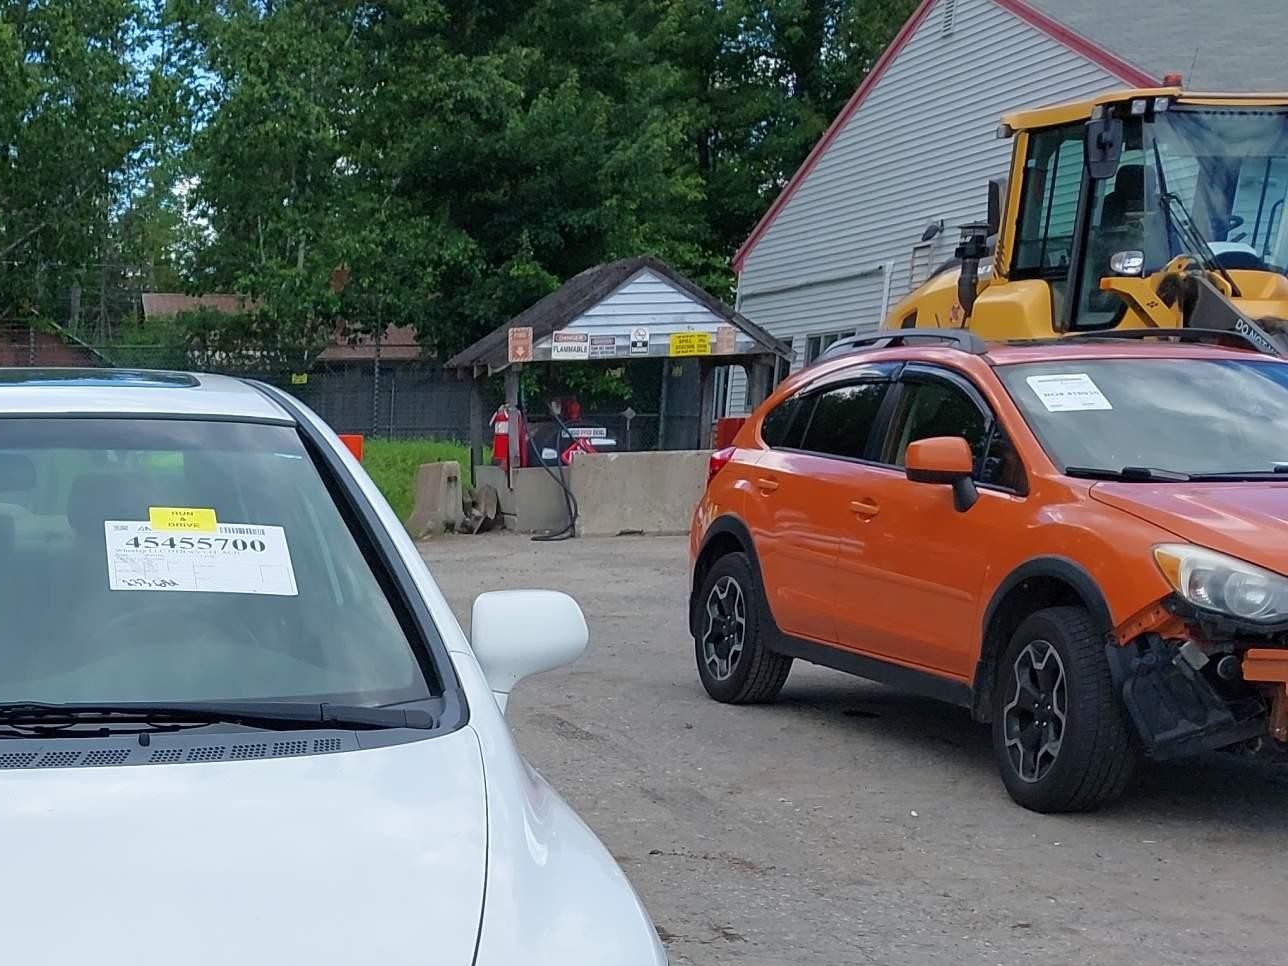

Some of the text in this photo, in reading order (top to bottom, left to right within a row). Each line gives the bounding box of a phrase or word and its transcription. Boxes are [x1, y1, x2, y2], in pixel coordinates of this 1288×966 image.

[1235, 318, 1249, 335] DO
[553, 345, 588, 354] FLAMMABLE
[125, 535, 267, 553] 45455700
